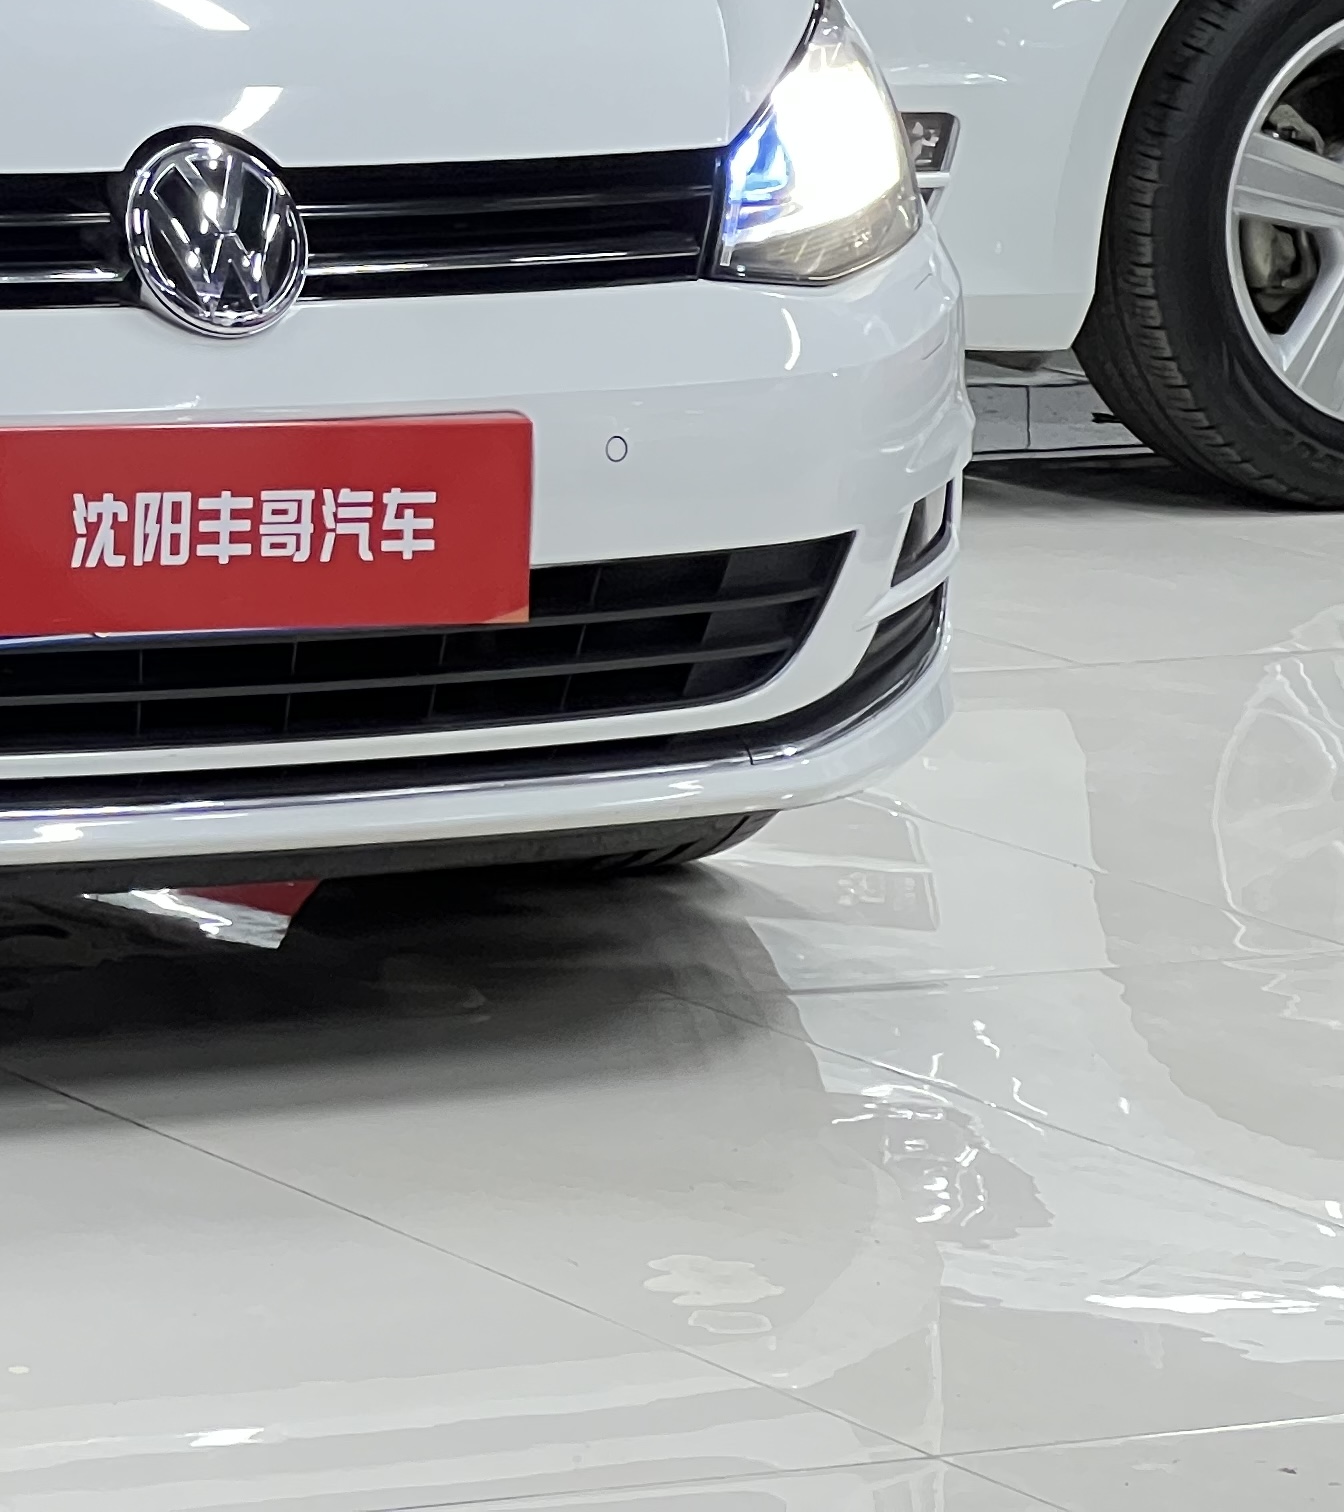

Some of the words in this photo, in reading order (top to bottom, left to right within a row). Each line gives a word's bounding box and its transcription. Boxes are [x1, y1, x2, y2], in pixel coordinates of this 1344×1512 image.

[70, 487, 438, 569] 沈阳丰哥汽车
